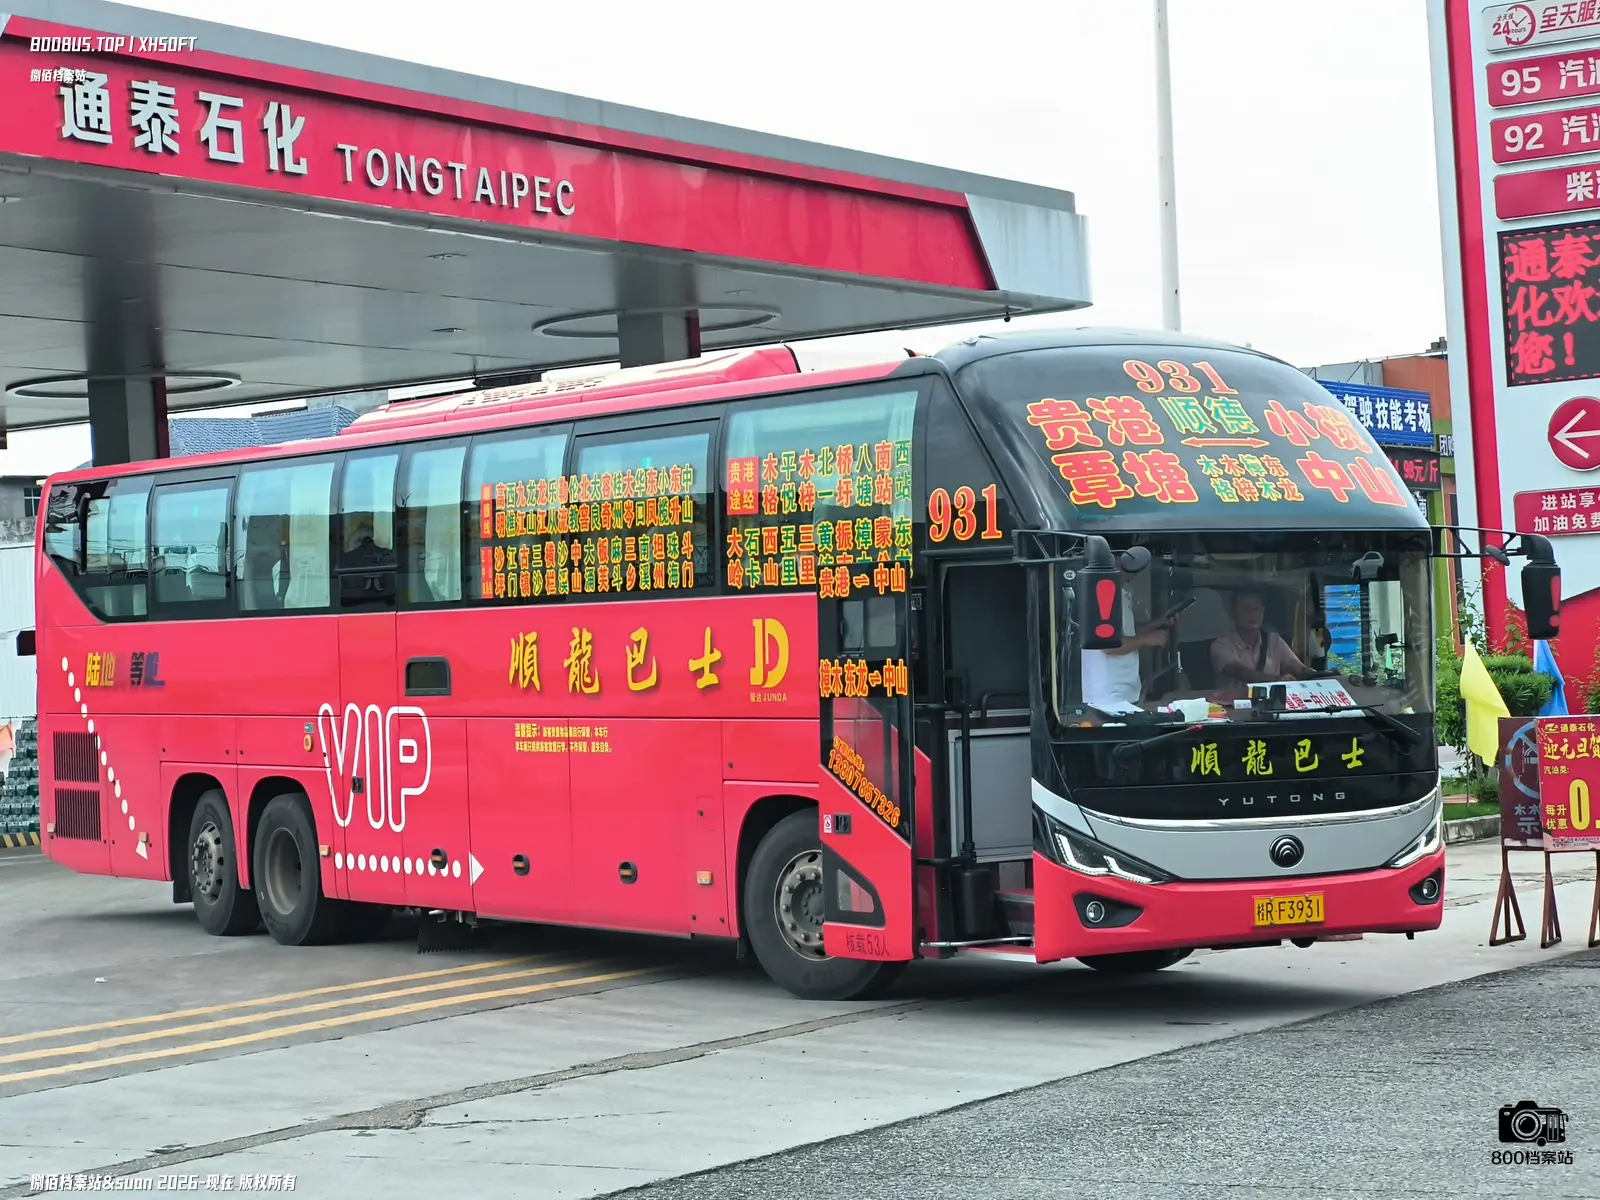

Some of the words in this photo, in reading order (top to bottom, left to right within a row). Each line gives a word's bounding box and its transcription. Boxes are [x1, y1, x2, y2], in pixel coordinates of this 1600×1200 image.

[1493, 22, 1510, 36] 24
[1540, 0, 1600, 29] 全天服
[1501, 67, 1541, 97] 95
[58, 68, 308, 175] 通泰石化
[336, 142, 576, 217] TONGTAIPEC
[1504, 122, 1545, 153] 92
[1566, 168, 1600, 203] 柴
[1505, 233, 1600, 284] 通泰
[1508, 280, 1600, 331] 化欢
[1123, 359, 1239, 396] 931
[1026, 395, 1165, 451] 贵港
[1157, 396, 1260, 435] 顺德
[1332, 393, 1432, 433] 驾驶技能考场
[730, 460, 754, 484] 贵港
[1051, 449, 1200, 510] 覃塘
[1296, 450, 1409, 509] 中山
[928, 483, 1003, 543] 931
[1541, 491, 1600, 511] 进站享
[819, 566, 850, 599] 贵港
[873, 562, 906, 595] 中山
[883, 658, 908, 697] 中山
[763, 692, 788, 703] JUNDA
[317, 702, 432, 833] VIP
[828, 749, 901, 828] 13807857326
[1218, 791, 1347, 807] YUTONG
[1545, 804, 1567, 816] 每升
[1546, 818, 1569, 830] 优惠
